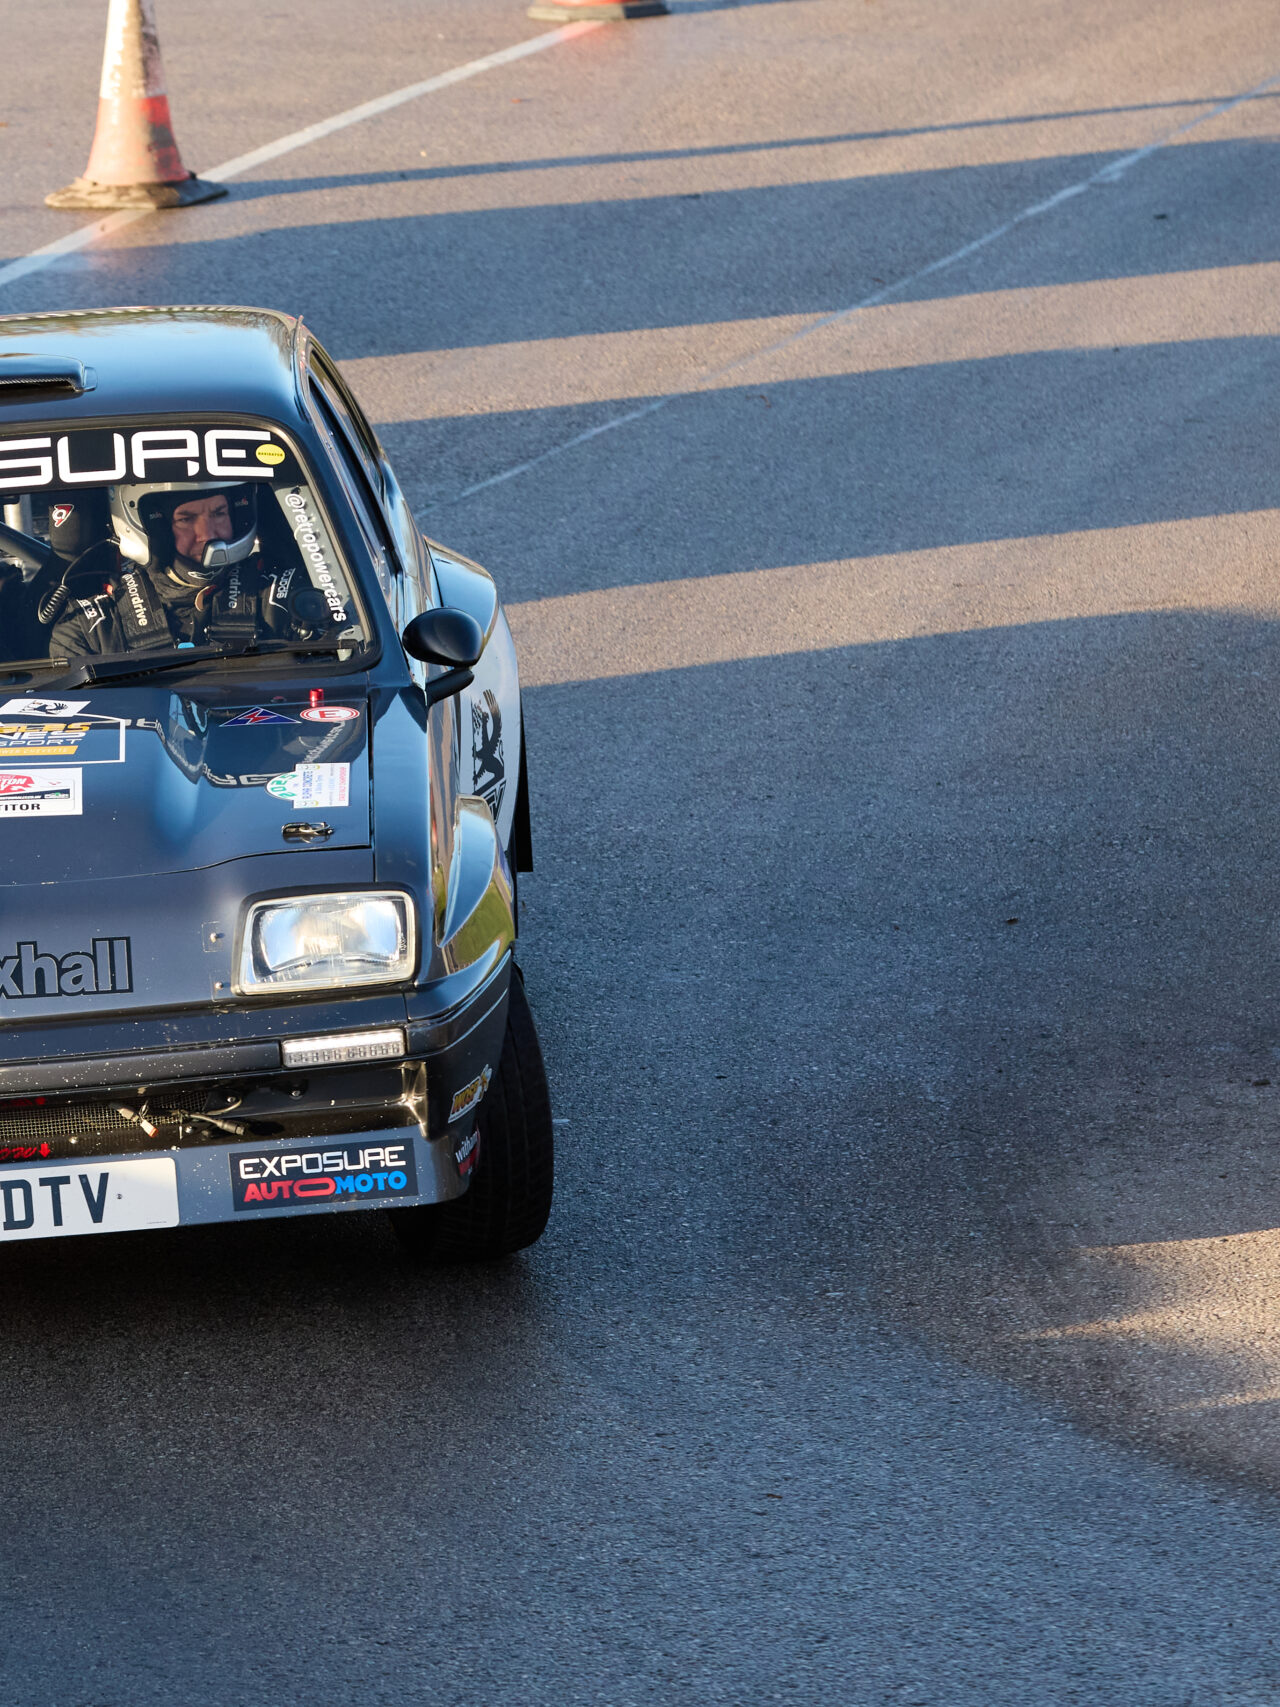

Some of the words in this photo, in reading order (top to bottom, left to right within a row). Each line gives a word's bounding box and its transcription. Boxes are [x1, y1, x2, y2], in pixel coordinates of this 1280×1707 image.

[285, 493, 346, 622] @retropowercars
[122, 574, 148, 626] motordrive
[319, 710, 341, 718] E
[271, 773, 298, 799] 2025
[239, 1145, 407, 1179] EXPOSURE
[0, 1172, 110, 1231] DTV
[243, 1171, 407, 1203] AUTOMOTO
